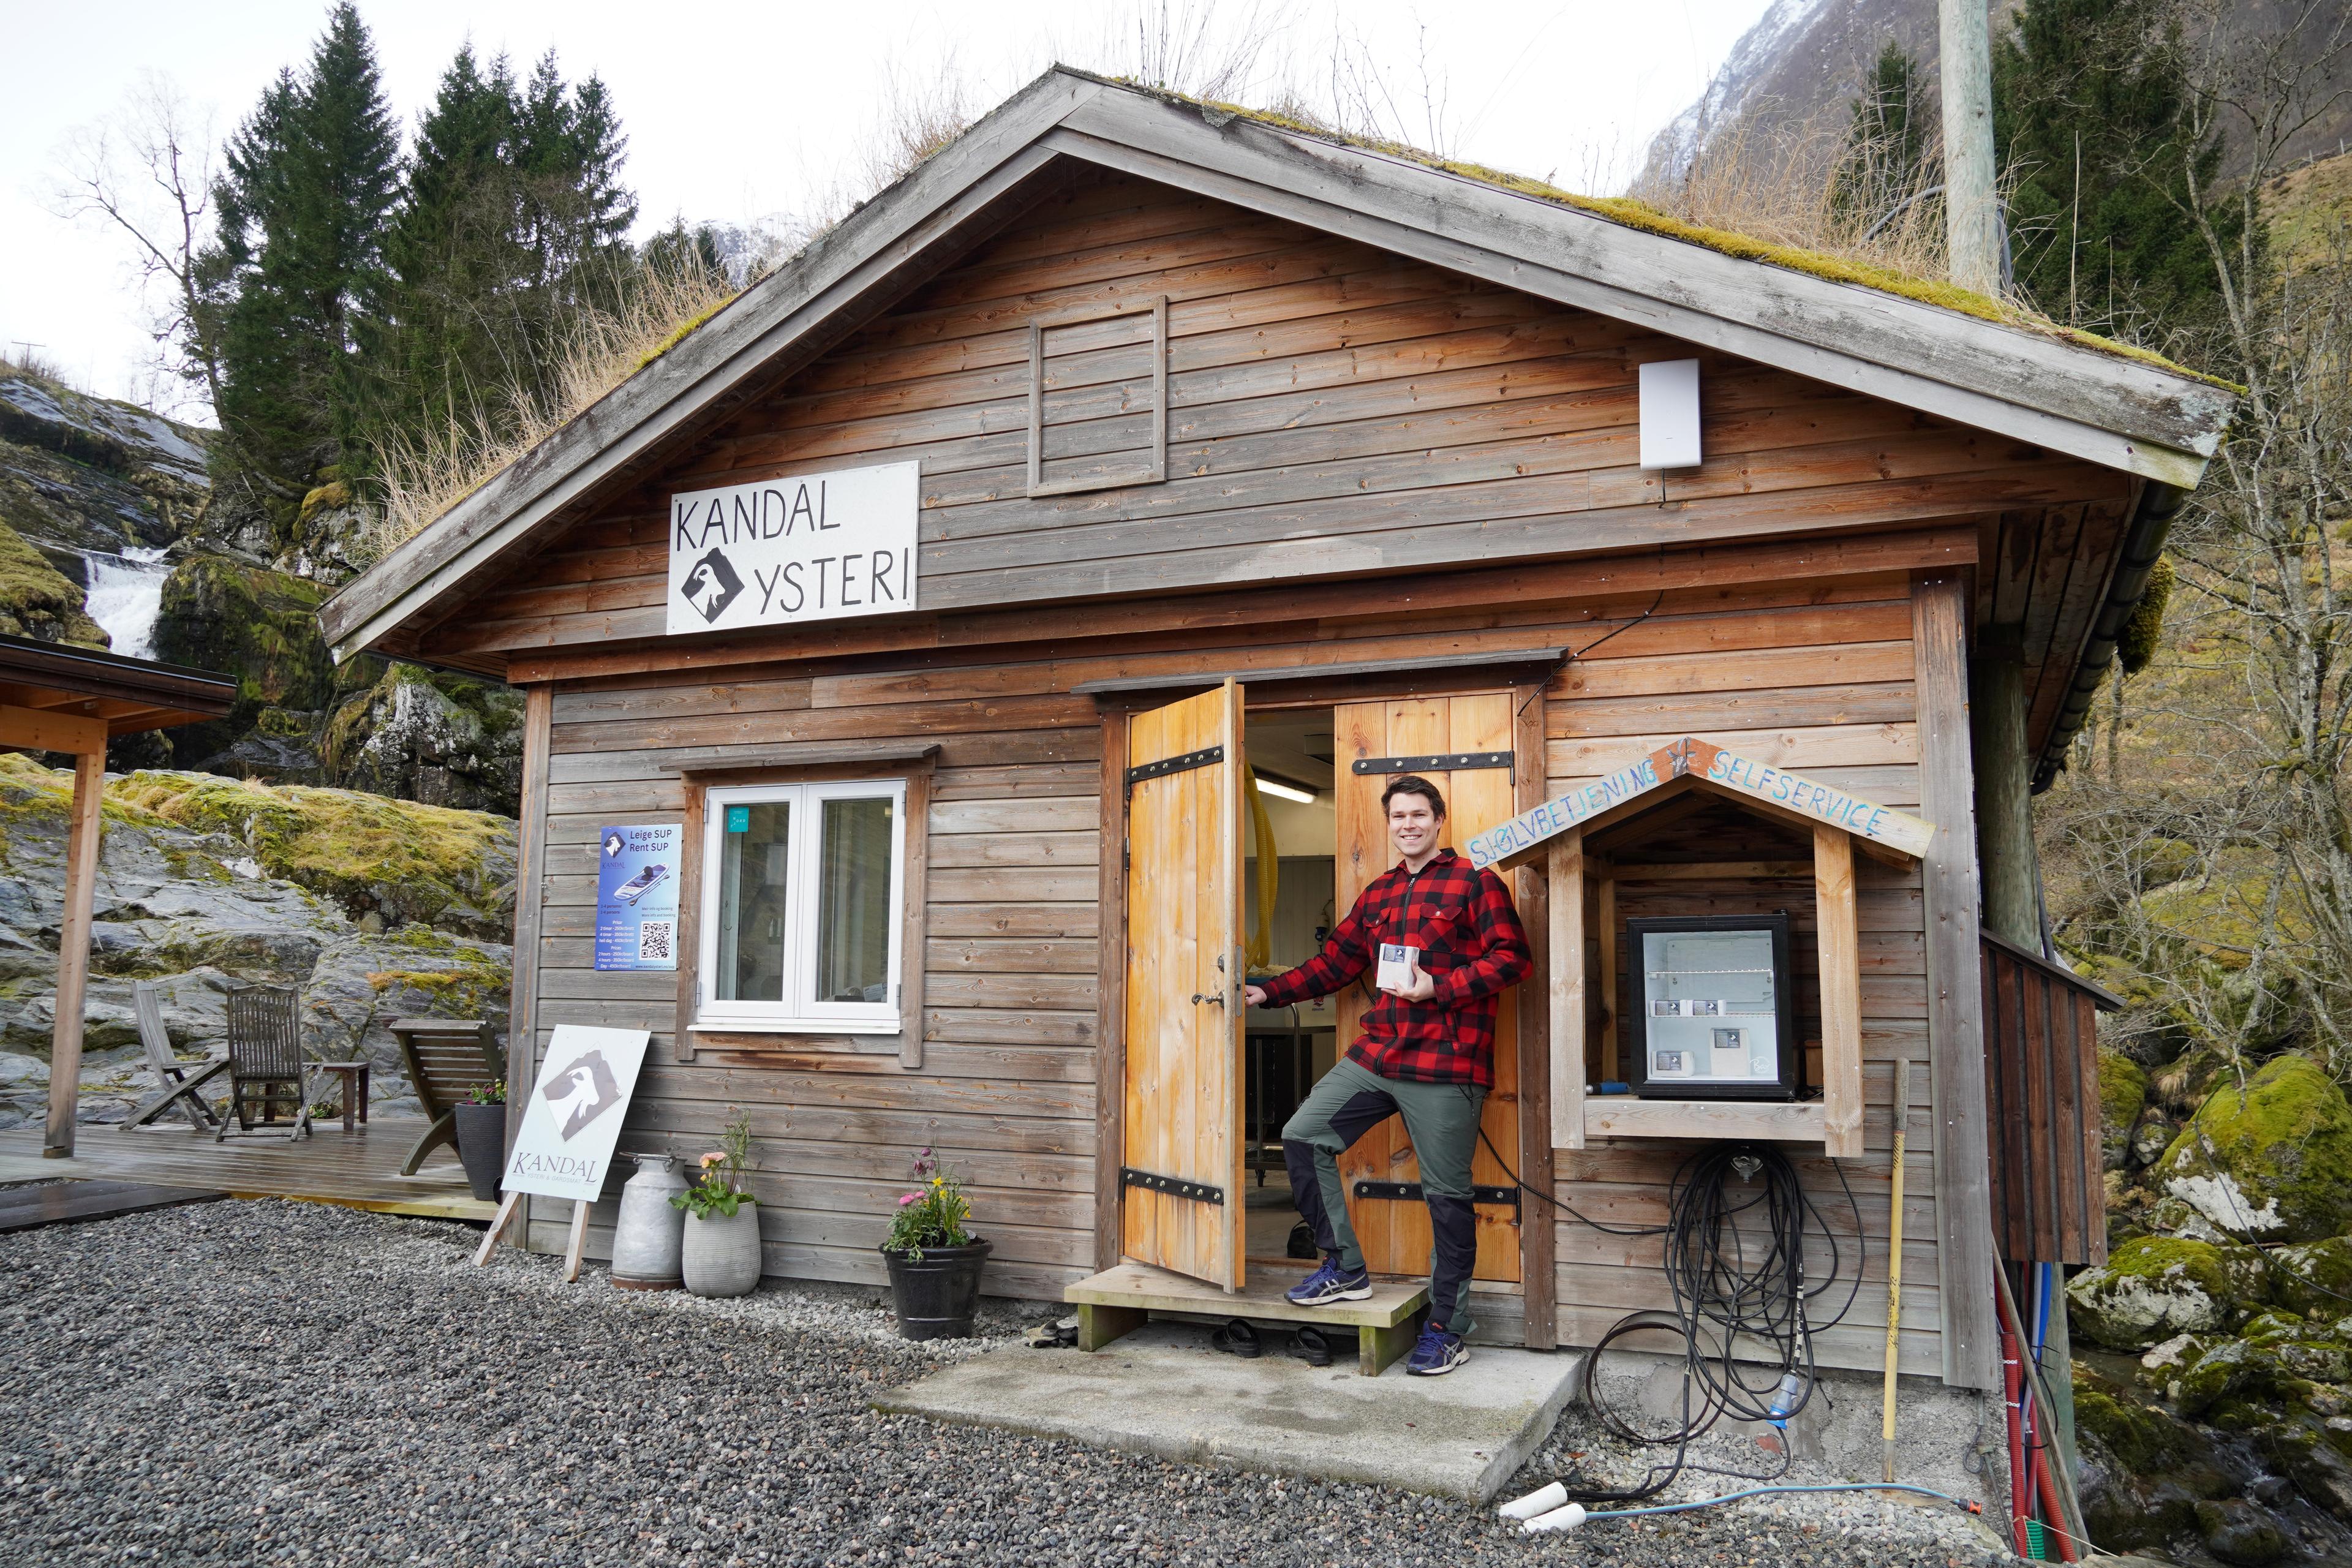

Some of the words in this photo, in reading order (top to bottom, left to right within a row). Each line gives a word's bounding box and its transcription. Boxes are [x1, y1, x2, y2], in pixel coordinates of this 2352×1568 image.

[676, 480, 840, 552] KANDAL
[754, 547, 909, 615] YSTERI
[1470, 758, 1658, 867] SJØLVBETJENING
[1708, 750, 1890, 836] SELFSERVICE
[630, 831, 652, 840] Leige
[654, 829, 672, 839] SUP
[630, 843, 649, 852] Rent
[651, 842, 669, 851] SUP
[513, 1152, 598, 1183] KANDAL
[551, 1175, 582, 1184] GARDSMAT
